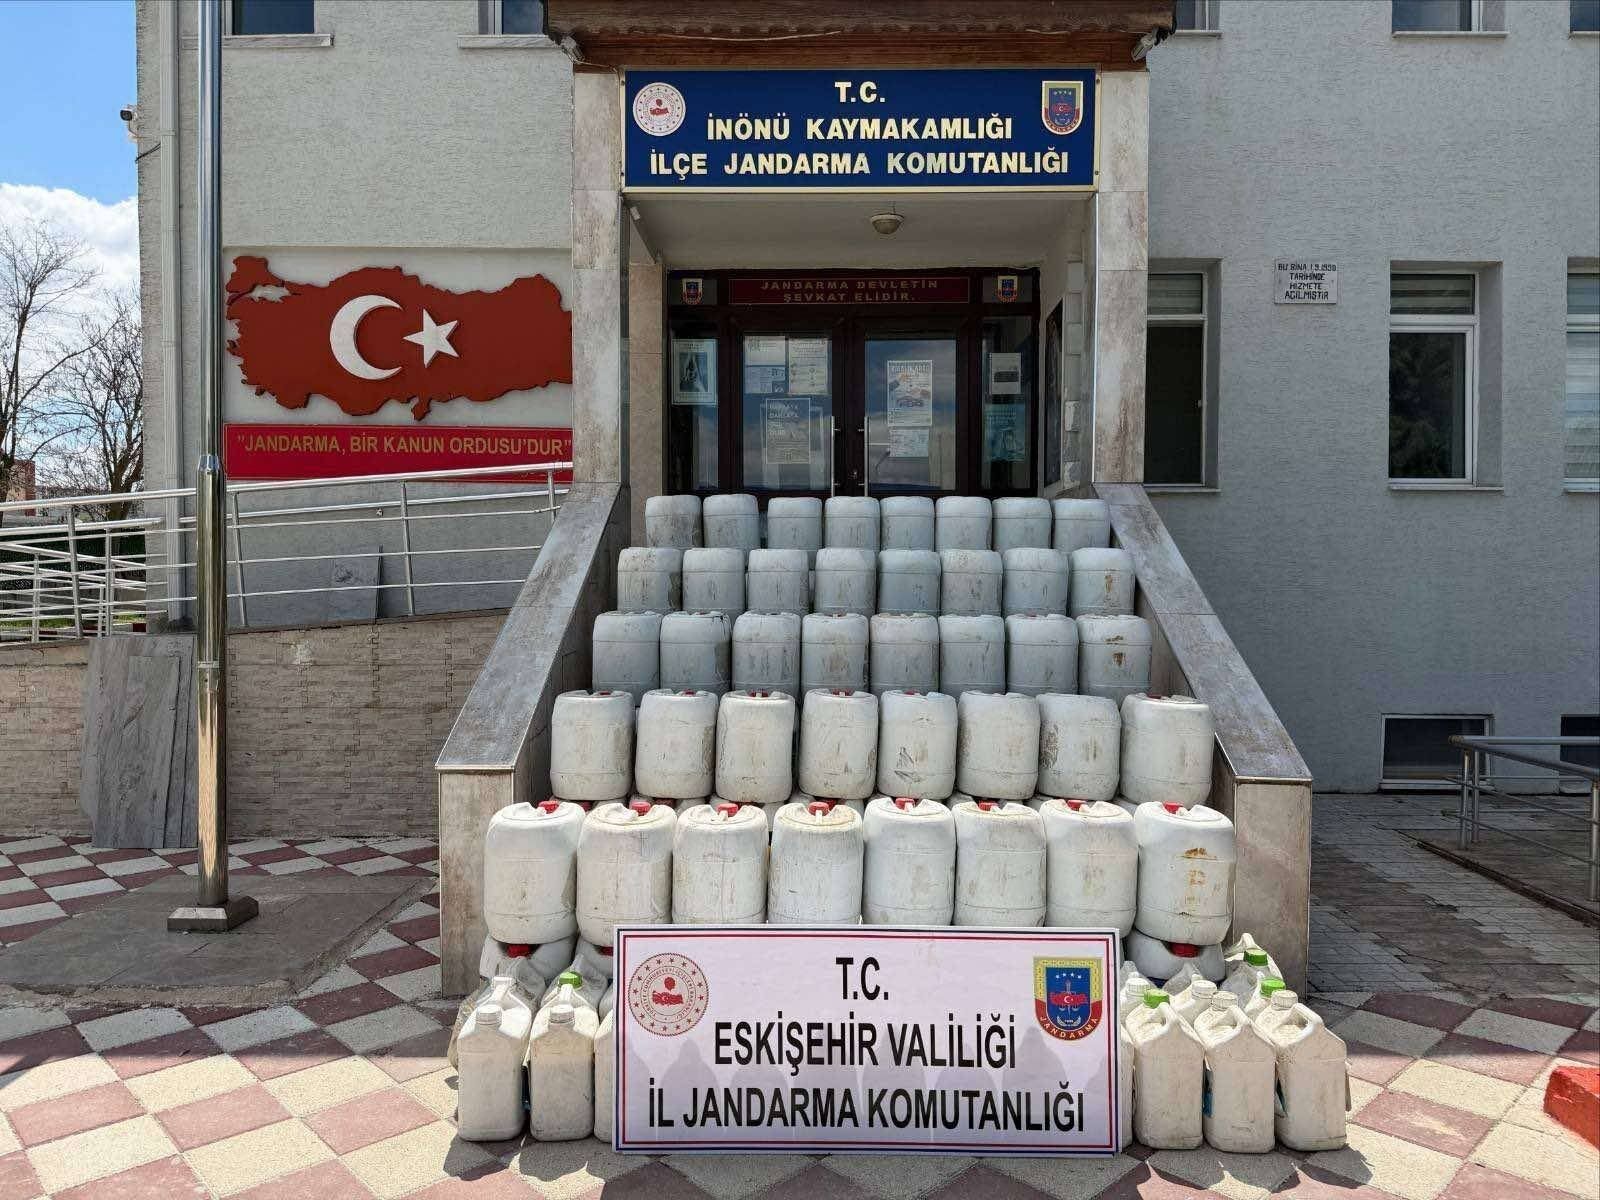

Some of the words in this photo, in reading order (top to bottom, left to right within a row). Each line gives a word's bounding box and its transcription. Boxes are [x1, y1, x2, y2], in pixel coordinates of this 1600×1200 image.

[834, 80, 886, 104] T.C.
[707, 112, 790, 140] İNÖNÜ
[806, 112, 1012, 140] KAYMAKAMLIĞI
[650, 148, 708, 181] İLÇE
[723, 152, 871, 175] JANDARMA
[887, 146, 1068, 174] KOMUTANLIĞI
[760, 280, 849, 290] JANDARMA
[855, 279, 938, 289] DEVLETİN
[351, 431, 379, 453] BİR
[384, 435, 444, 453] KANUN
[835, 956, 890, 1001] T.C.
[1040, 1016, 1098, 1039] JANDARMA
[715, 1010, 880, 1077] ESKİŞEHİR
[887, 1012, 1016, 1069] VALİLİĞİ
[649, 1077, 675, 1128] İL
[682, 1087, 860, 1129] JANDARMA
[868, 1081, 1084, 1132] KOMUTANLIĞI
